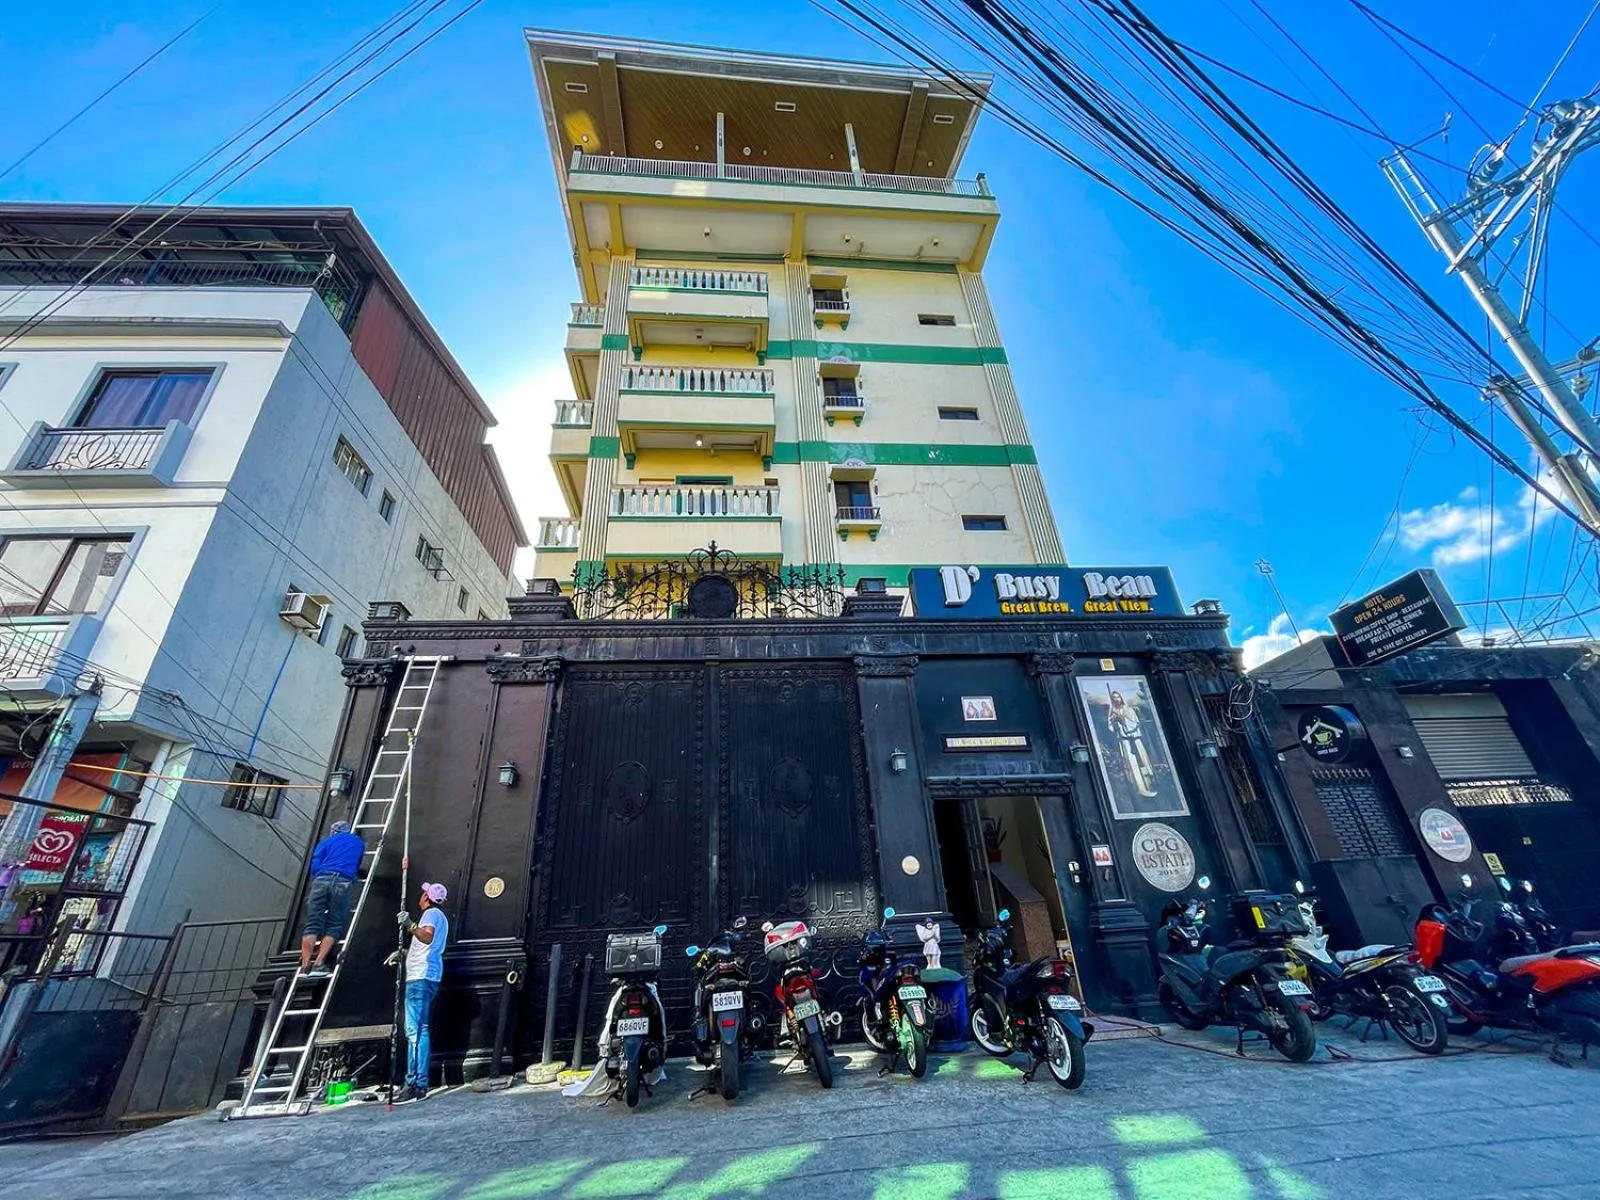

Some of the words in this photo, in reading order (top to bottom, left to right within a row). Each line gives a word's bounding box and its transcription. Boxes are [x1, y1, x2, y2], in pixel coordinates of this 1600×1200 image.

[939, 565, 980, 605] D'
[994, 573, 1060, 602] Busy
[1083, 572, 1158, 599] Bean
[1001, 601, 1036, 614] Great
[1084, 600, 1119, 613] Great
[1354, 611, 1373, 624] OPEN
[1371, 605, 1383, 616] 24
[1382, 594, 1406, 610] HOURS
[1364, 594, 1386, 609] HOTEL
[1369, 618, 1387, 629] COFFEE
[1386, 612, 1399, 621] SHOP
[1371, 630, 1392, 645] PRIVATE
[1141, 837, 1180, 853] CPG
